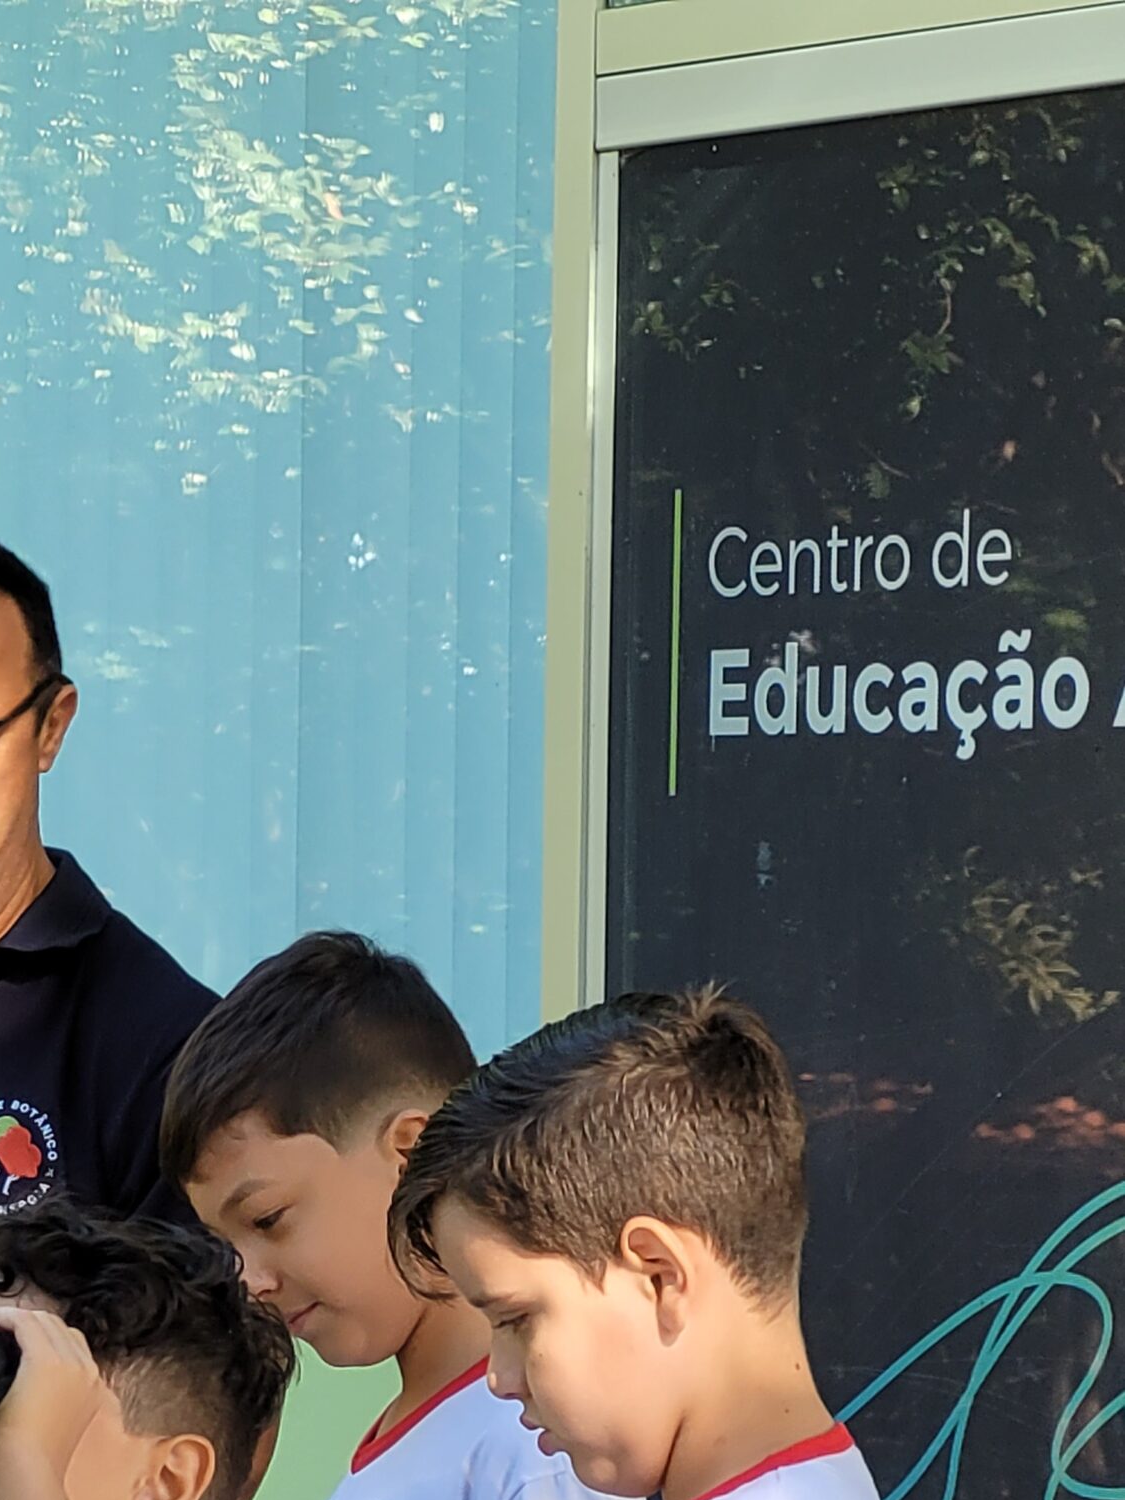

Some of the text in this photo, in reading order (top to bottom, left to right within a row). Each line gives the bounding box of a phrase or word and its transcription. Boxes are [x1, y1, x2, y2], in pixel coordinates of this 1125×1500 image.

[708, 508, 1013, 598] Centro de
[708, 628, 1090, 761] Educação
[10, 1099, 58, 1161] BOTÂNICO
